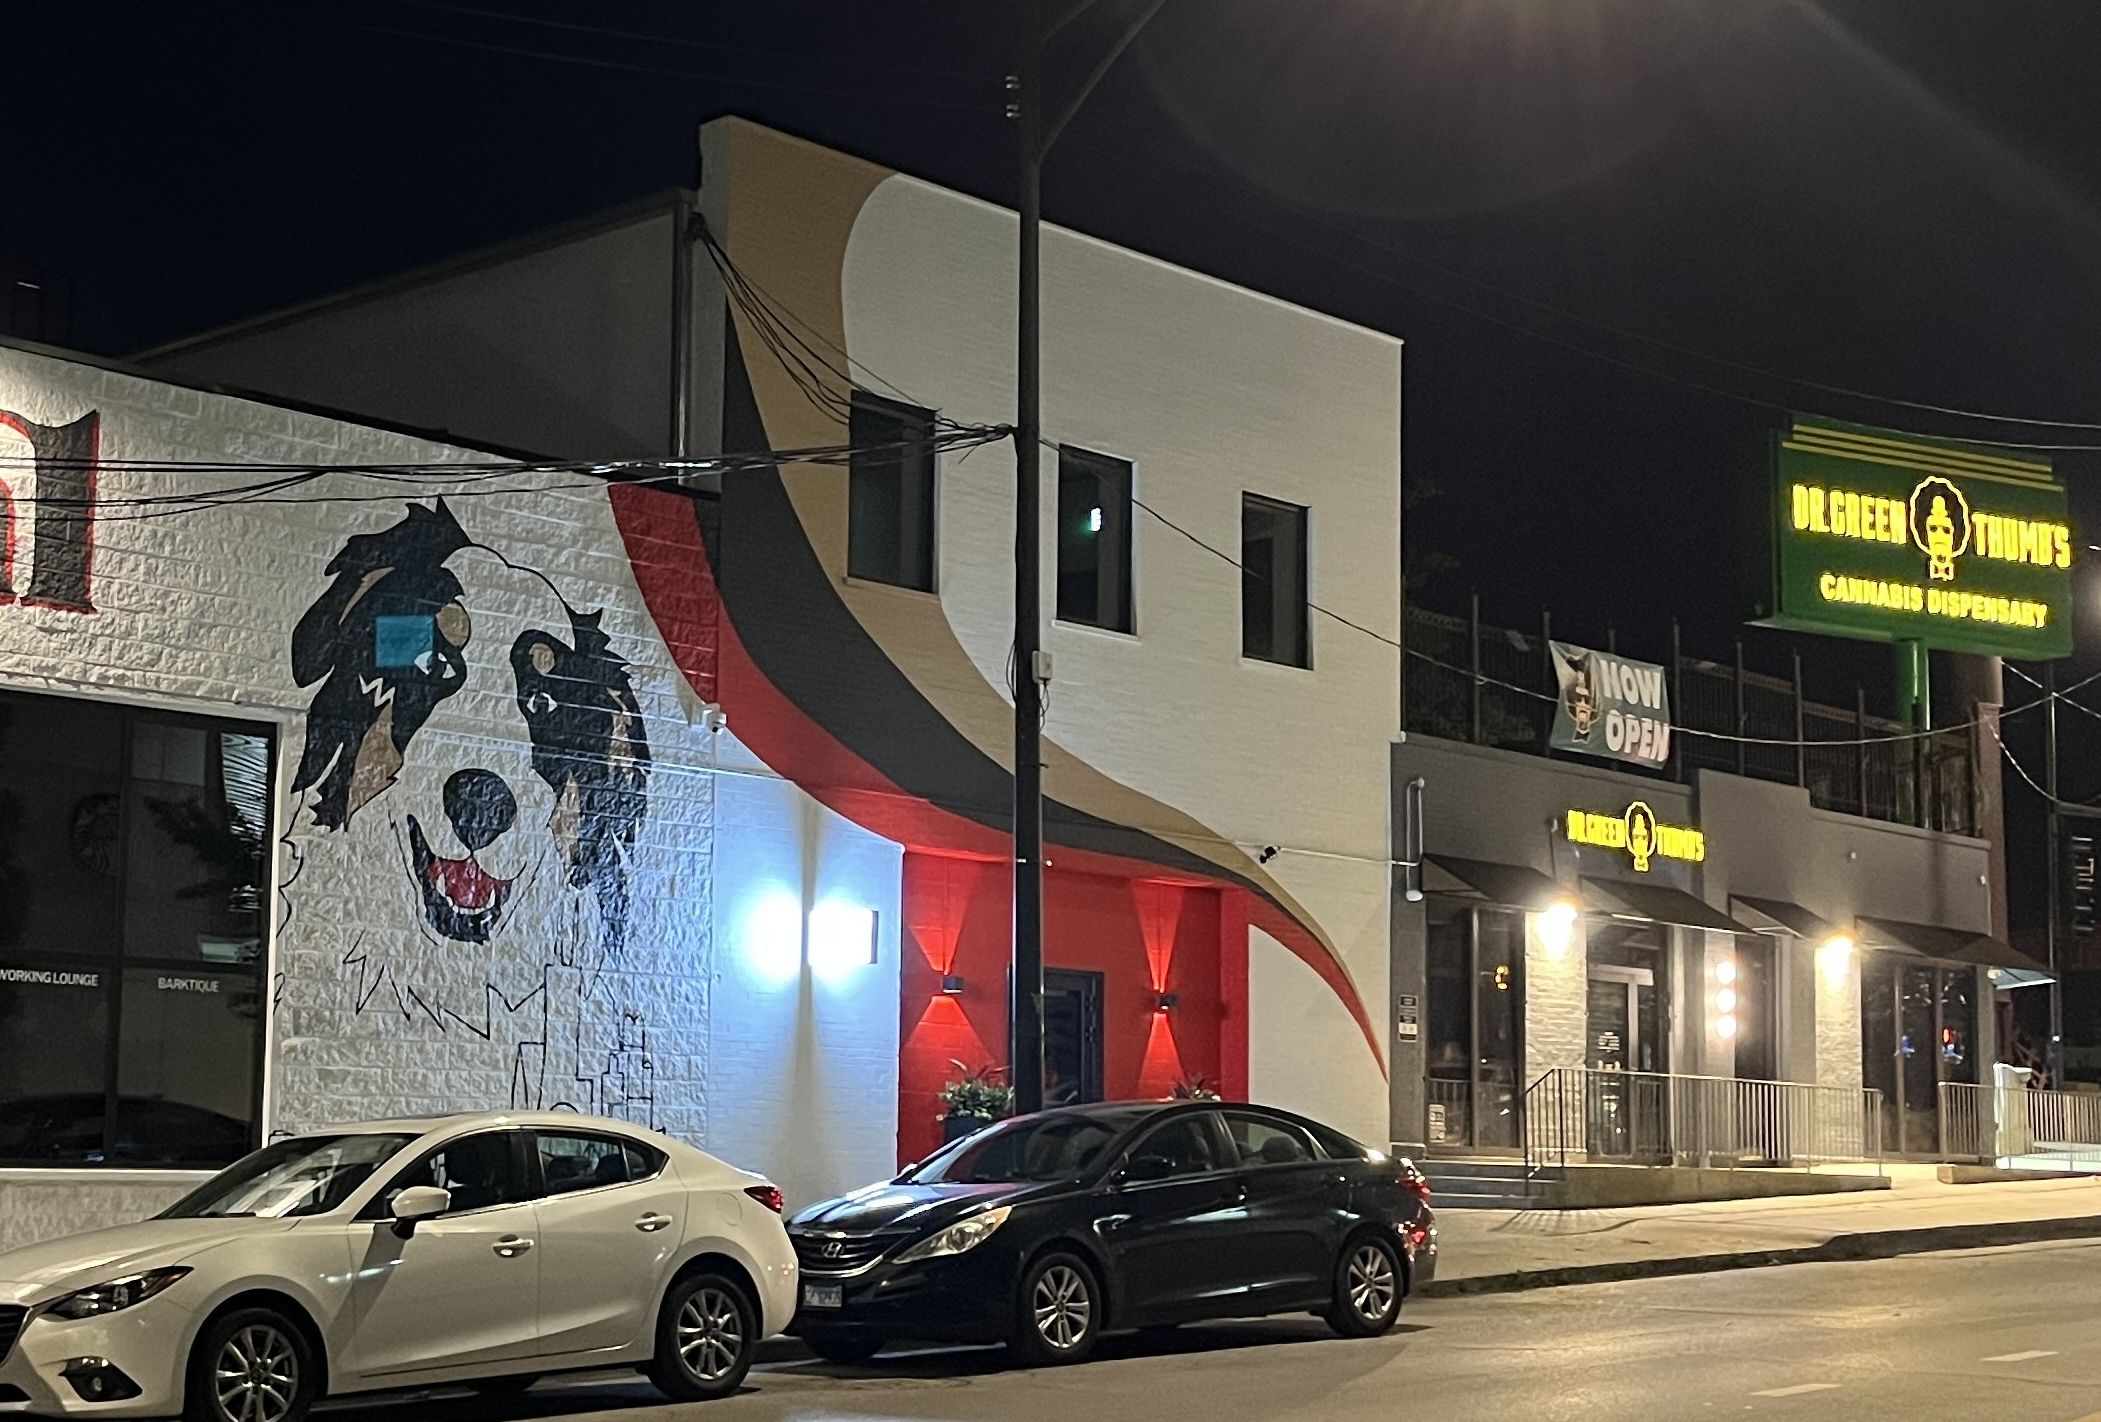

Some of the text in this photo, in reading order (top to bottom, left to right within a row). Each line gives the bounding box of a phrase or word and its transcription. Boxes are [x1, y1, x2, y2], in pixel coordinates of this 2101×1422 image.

[1820, 573, 2048, 629] CANNABIS DISPENSARY
[1600, 659, 1661, 709] NOW
[1606, 709, 1670, 762] OPEN
[52, 972, 99, 987] LOUNGE
[158, 977, 219, 993] BARKTIQUE
